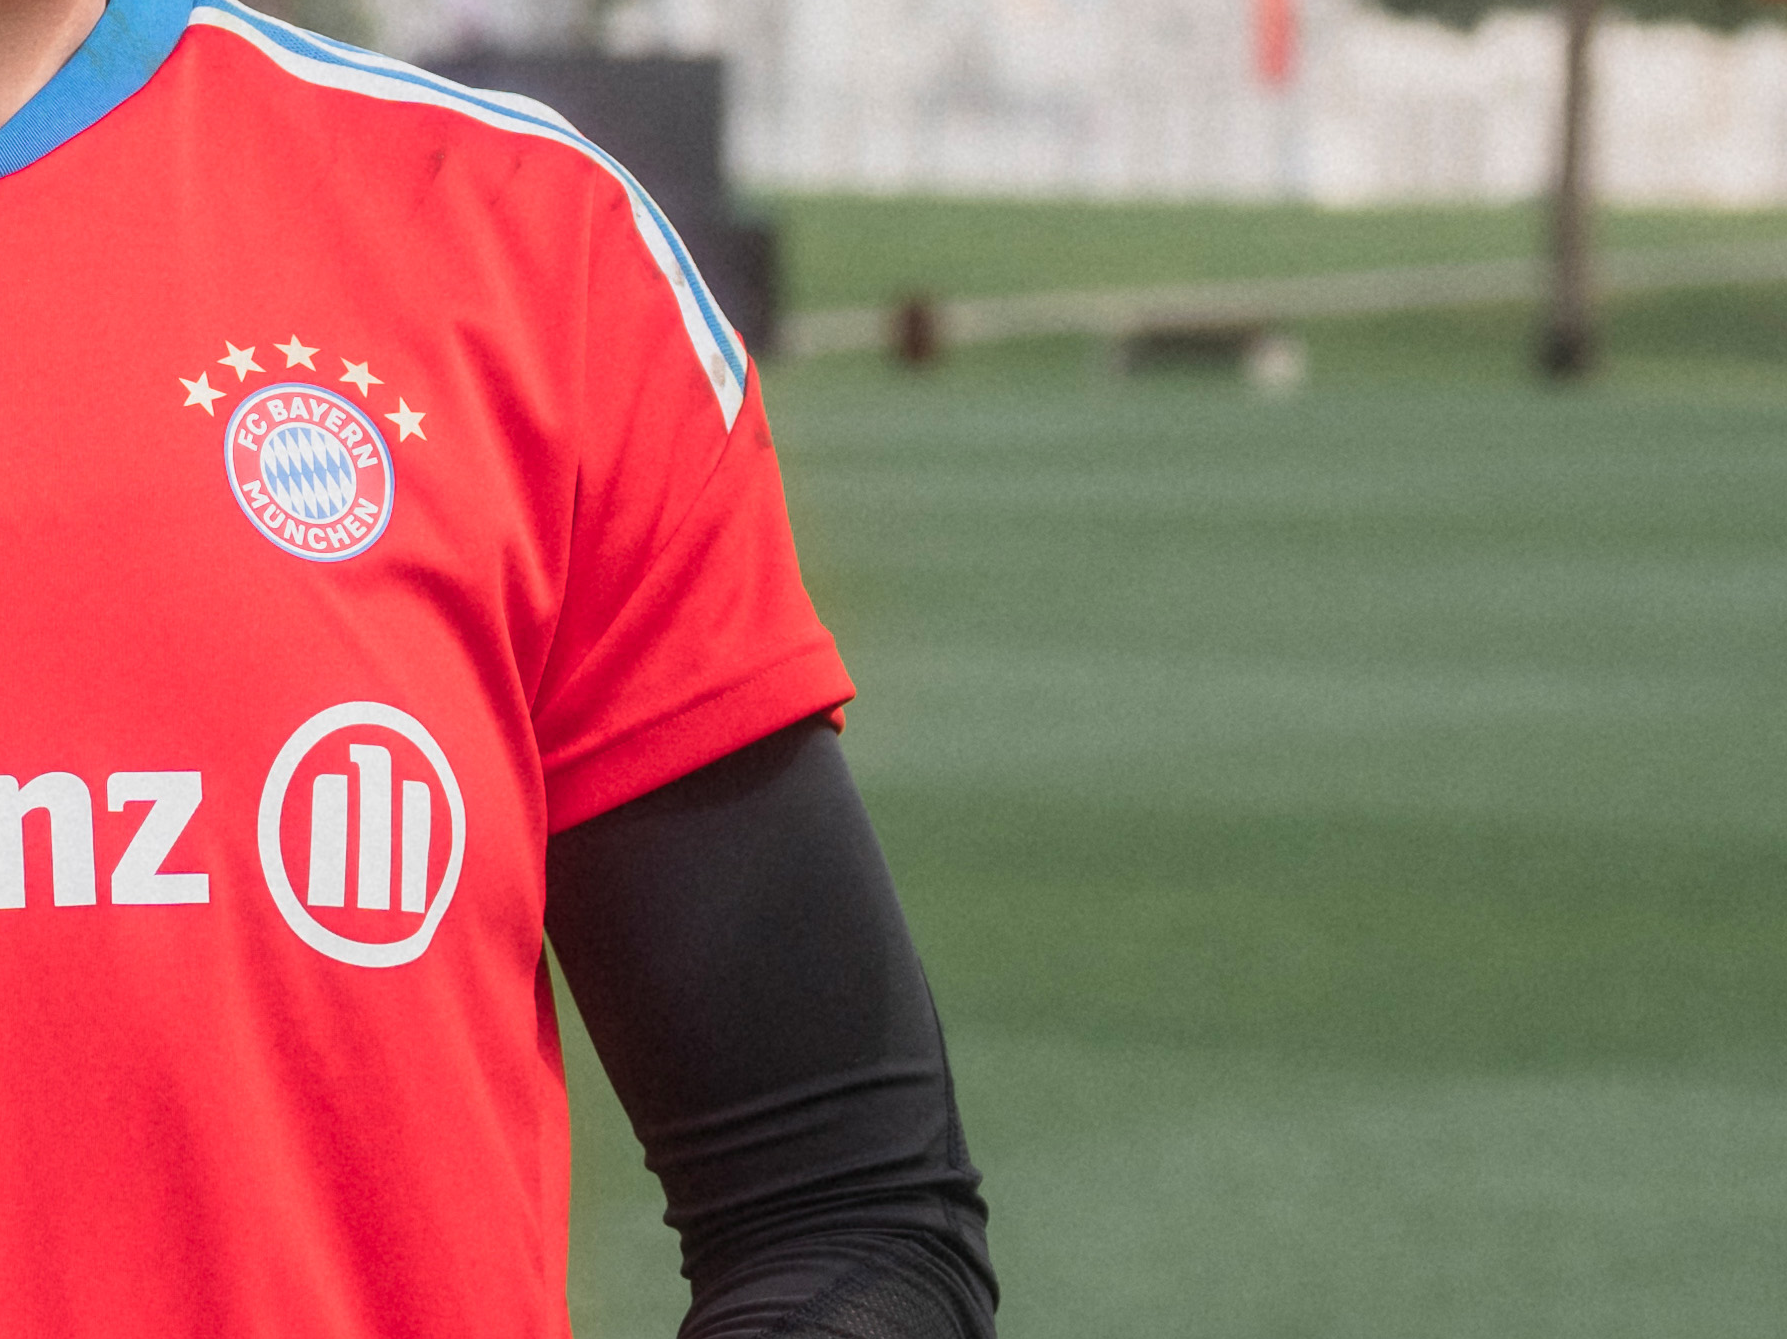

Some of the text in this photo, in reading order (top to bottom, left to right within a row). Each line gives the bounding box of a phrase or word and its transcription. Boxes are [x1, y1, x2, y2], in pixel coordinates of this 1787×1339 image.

[236, 395, 379, 471] FC BAYERN
[241, 479, 380, 551] MÜNCHEN
